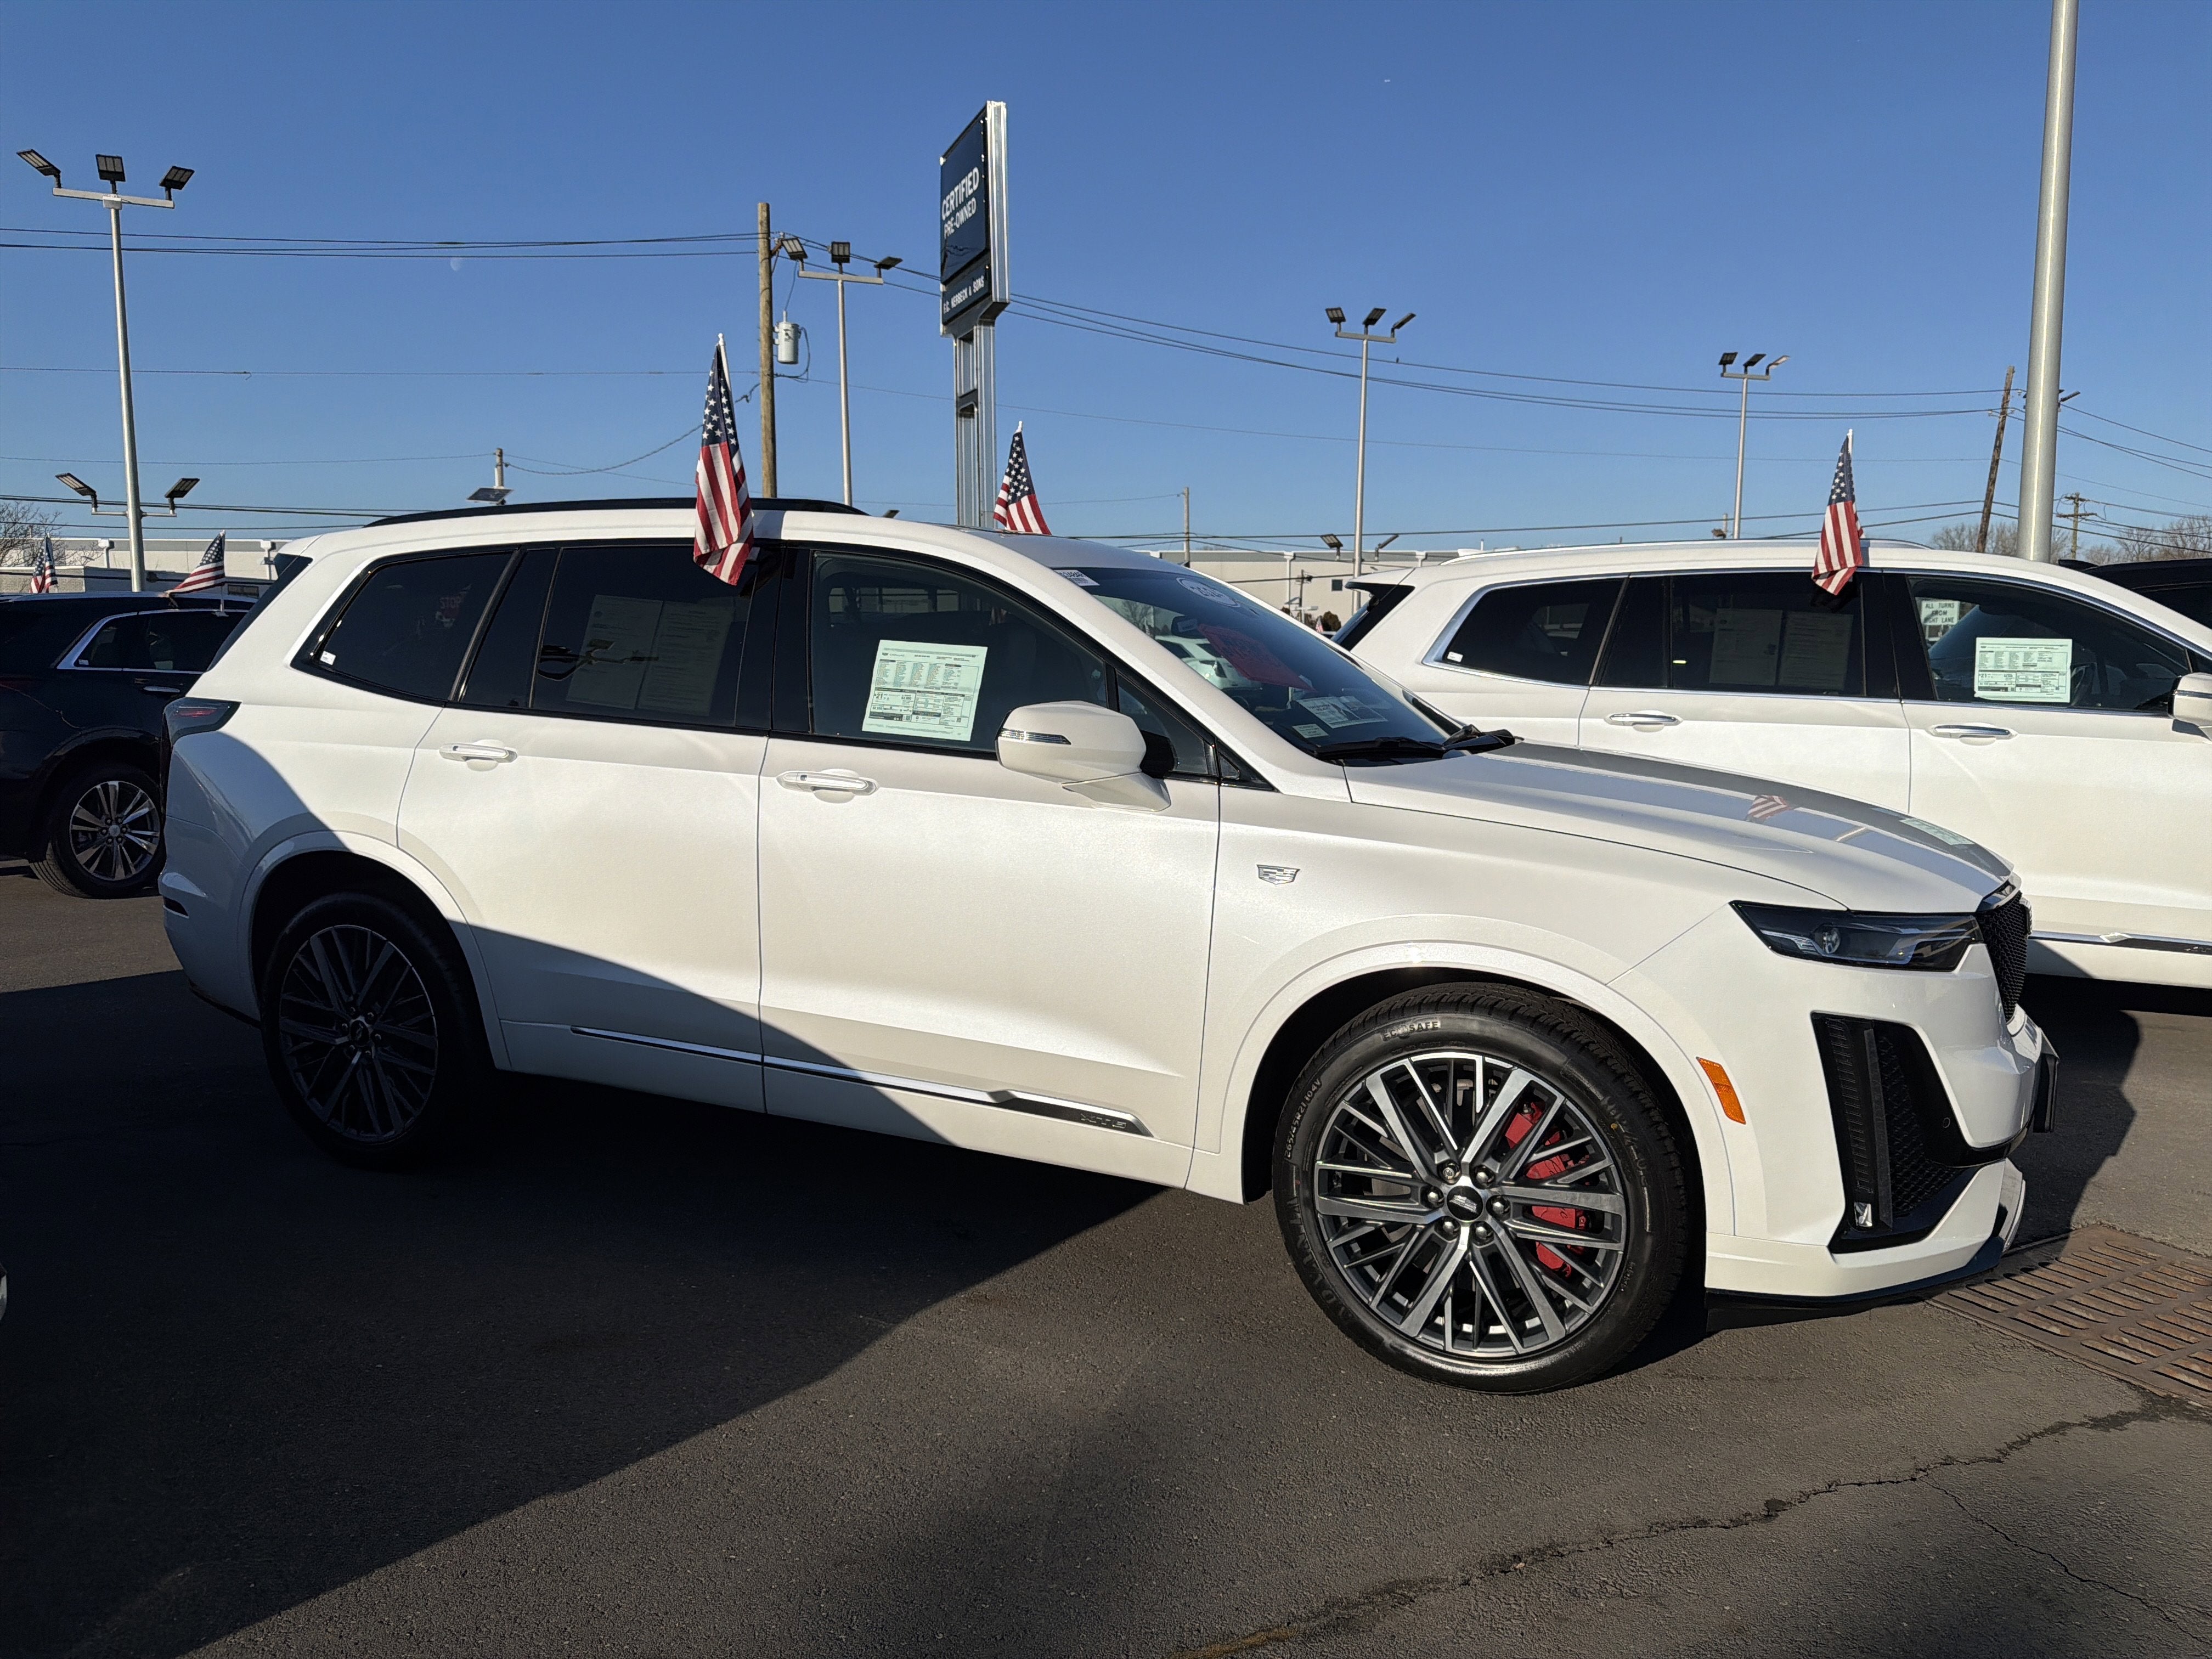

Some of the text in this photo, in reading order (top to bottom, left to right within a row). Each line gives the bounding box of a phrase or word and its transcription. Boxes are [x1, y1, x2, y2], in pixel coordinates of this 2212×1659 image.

[941, 167, 979, 221] CERTIFIED
[944, 197, 977, 239] PRE-OWNED
[973, 275, 985, 293] SONS
[439, 596, 460, 608] STOP
[1304, 1079, 1321, 1102] 104V
